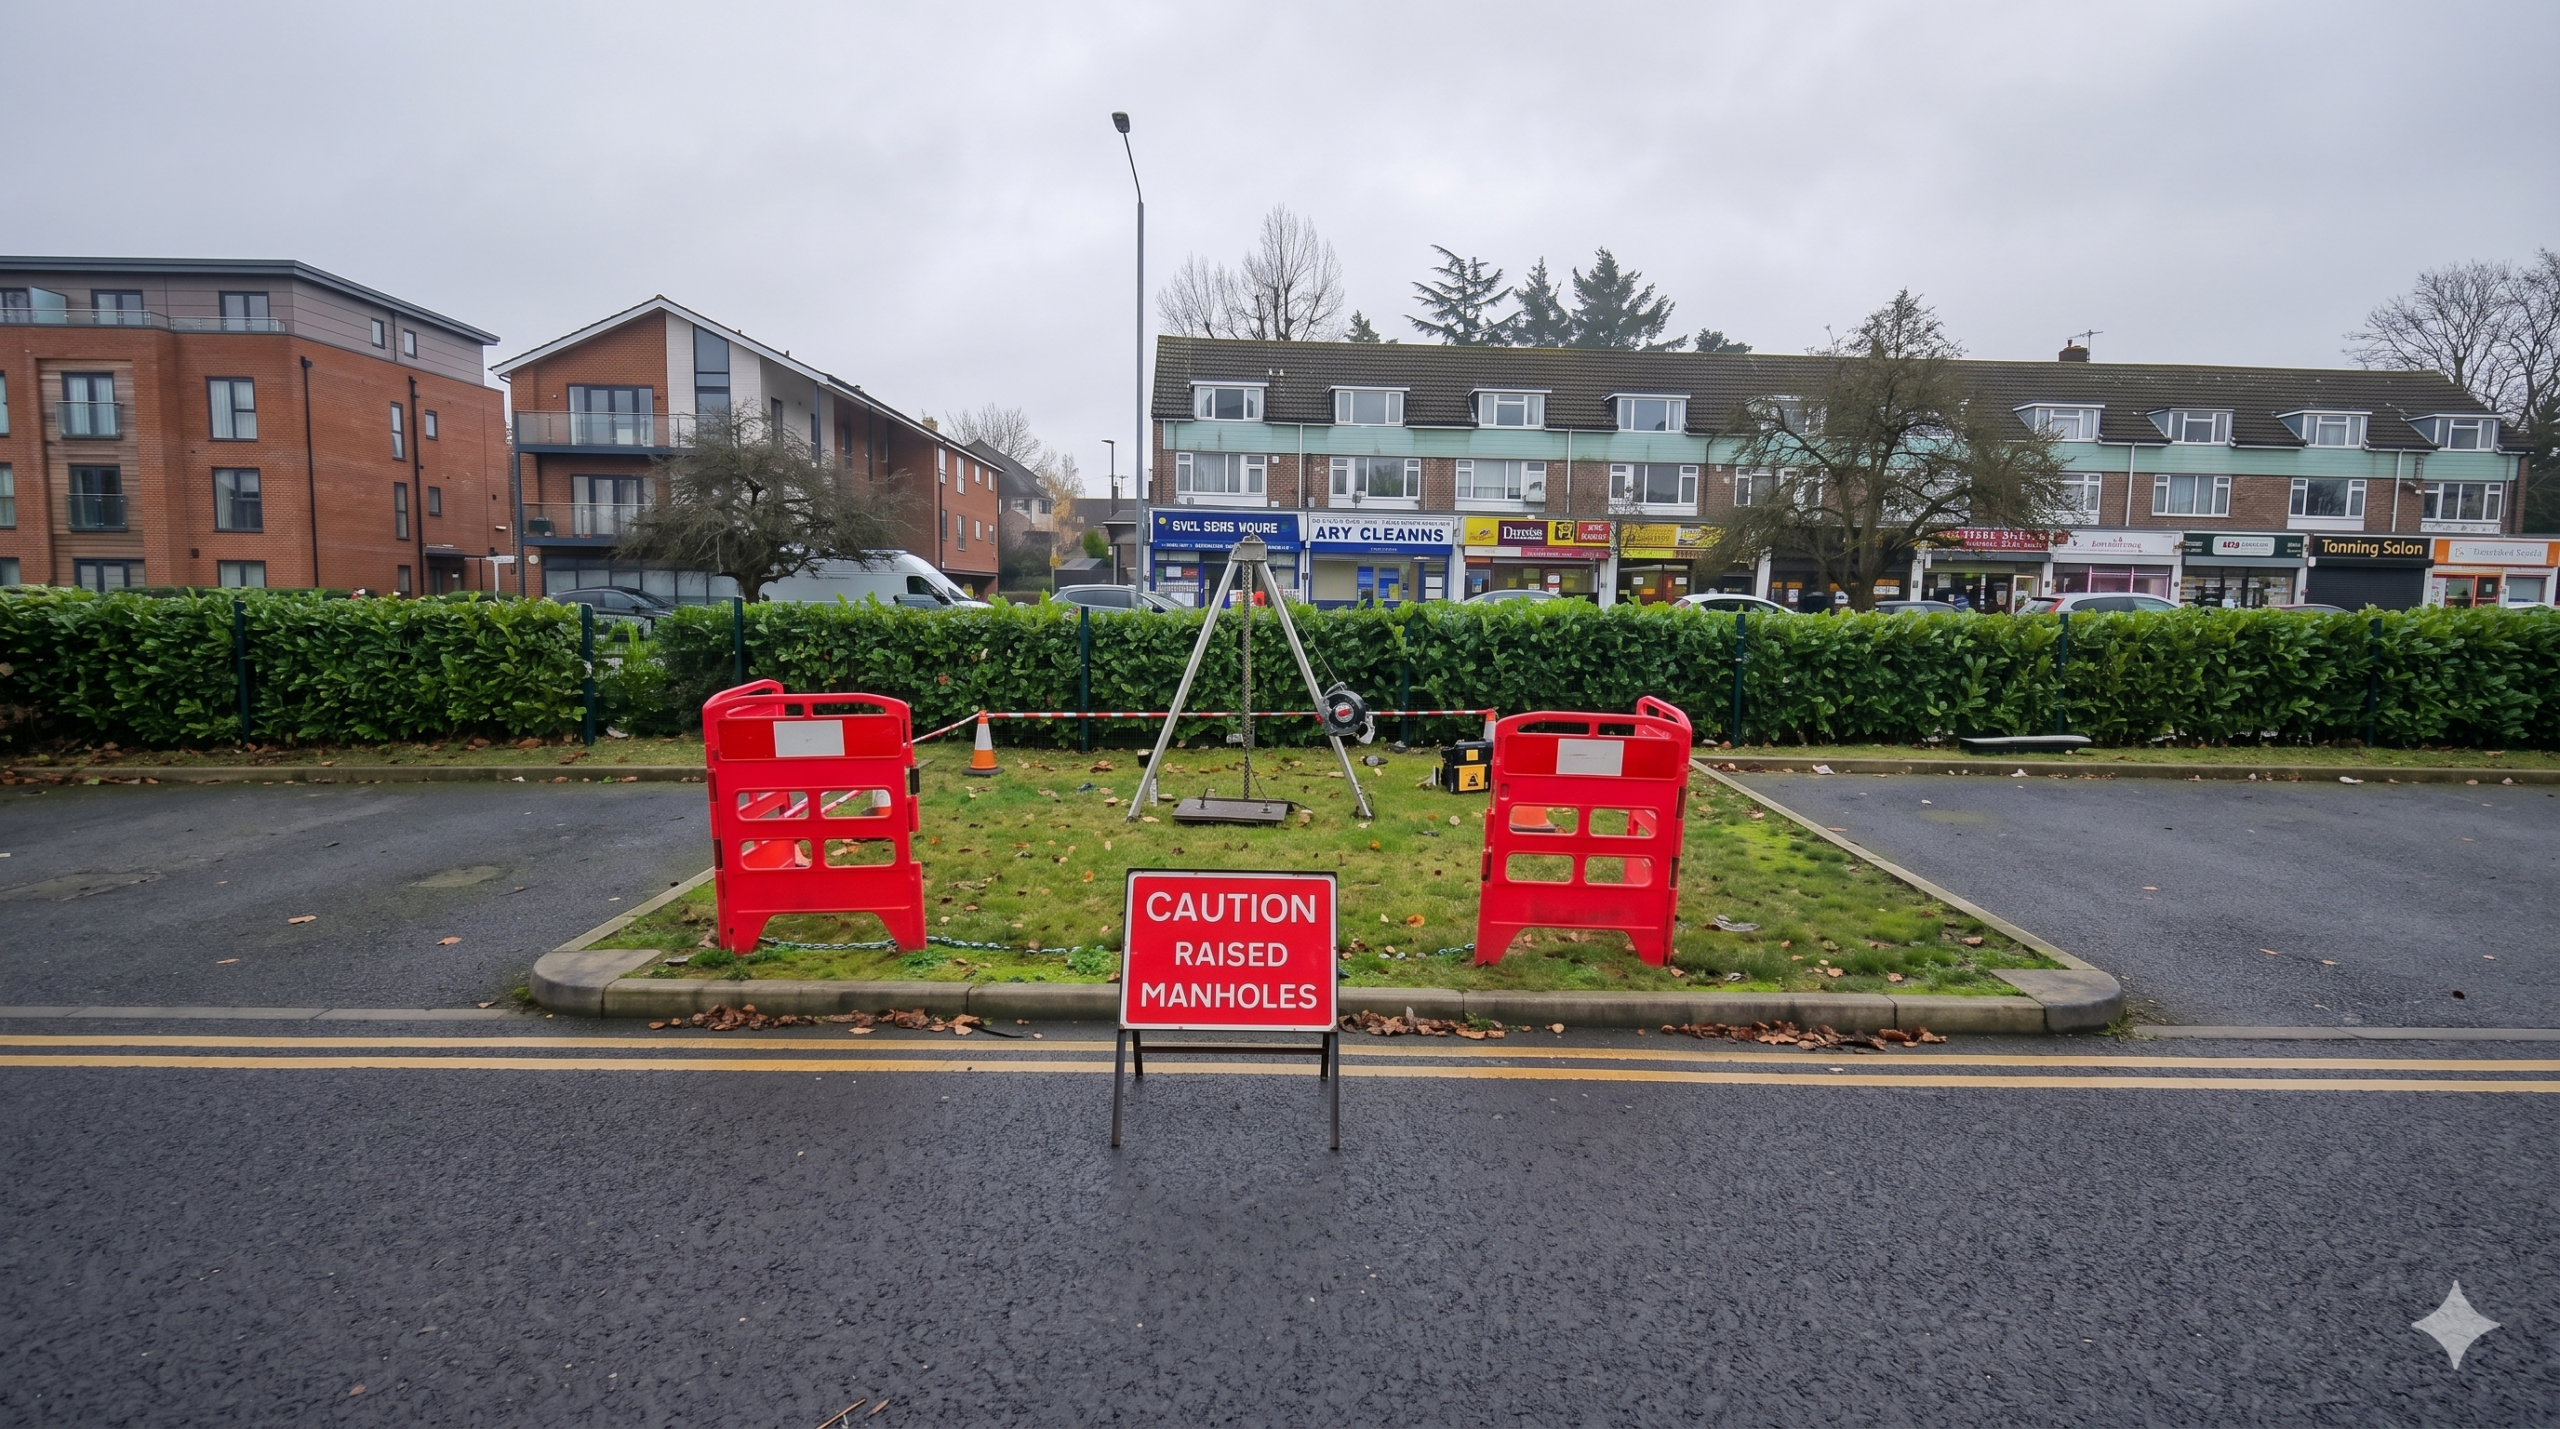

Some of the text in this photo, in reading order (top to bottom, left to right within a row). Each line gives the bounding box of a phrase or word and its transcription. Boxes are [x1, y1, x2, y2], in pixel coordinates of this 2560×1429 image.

[1315, 526, 1444, 542] ARY CLEANNS
[2382, 540, 2423, 555] Salon
[1146, 891, 1316, 924] CAUTION
[1175, 941, 1288, 968] RAISED
[1140, 982, 1318, 1010] MANHOLES
